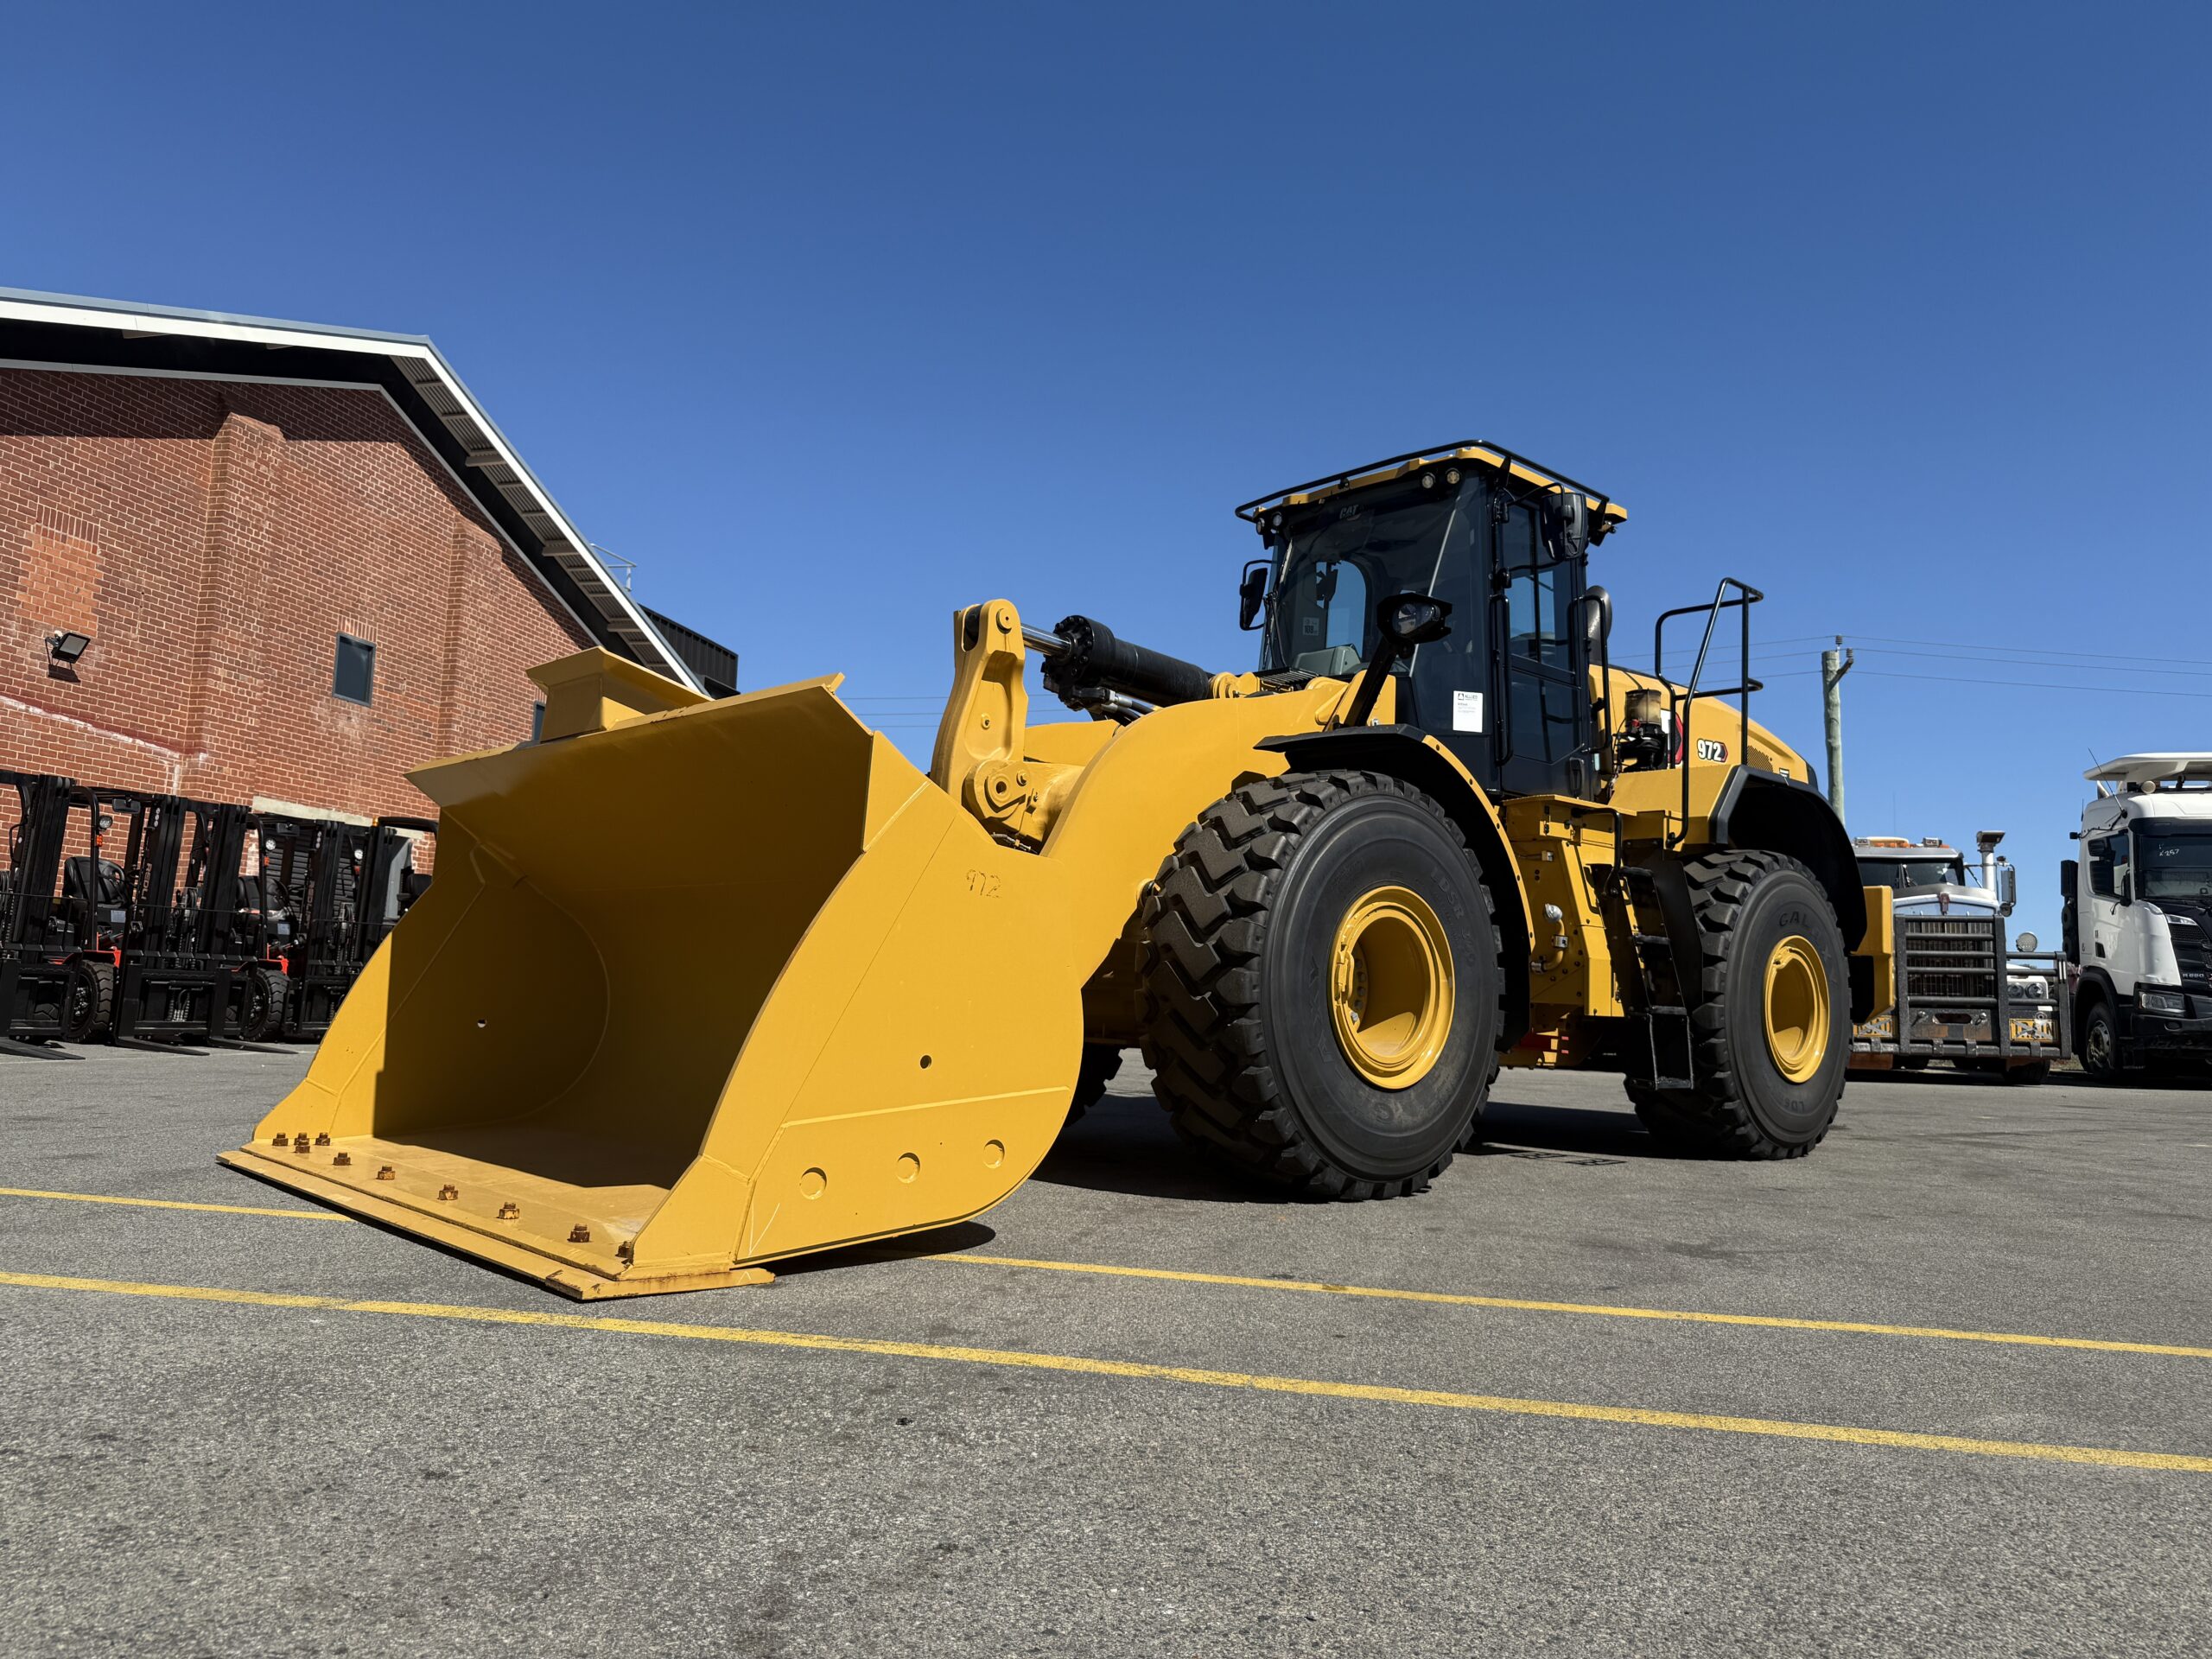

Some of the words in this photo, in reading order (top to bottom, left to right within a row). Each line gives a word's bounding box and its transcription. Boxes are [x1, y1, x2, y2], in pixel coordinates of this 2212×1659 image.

[1339, 505, 1359, 519] CAT
[1697, 739, 1722, 761] 972
[139, 862, 152, 918] REDLIT
[966, 869, 1002, 898] 972
